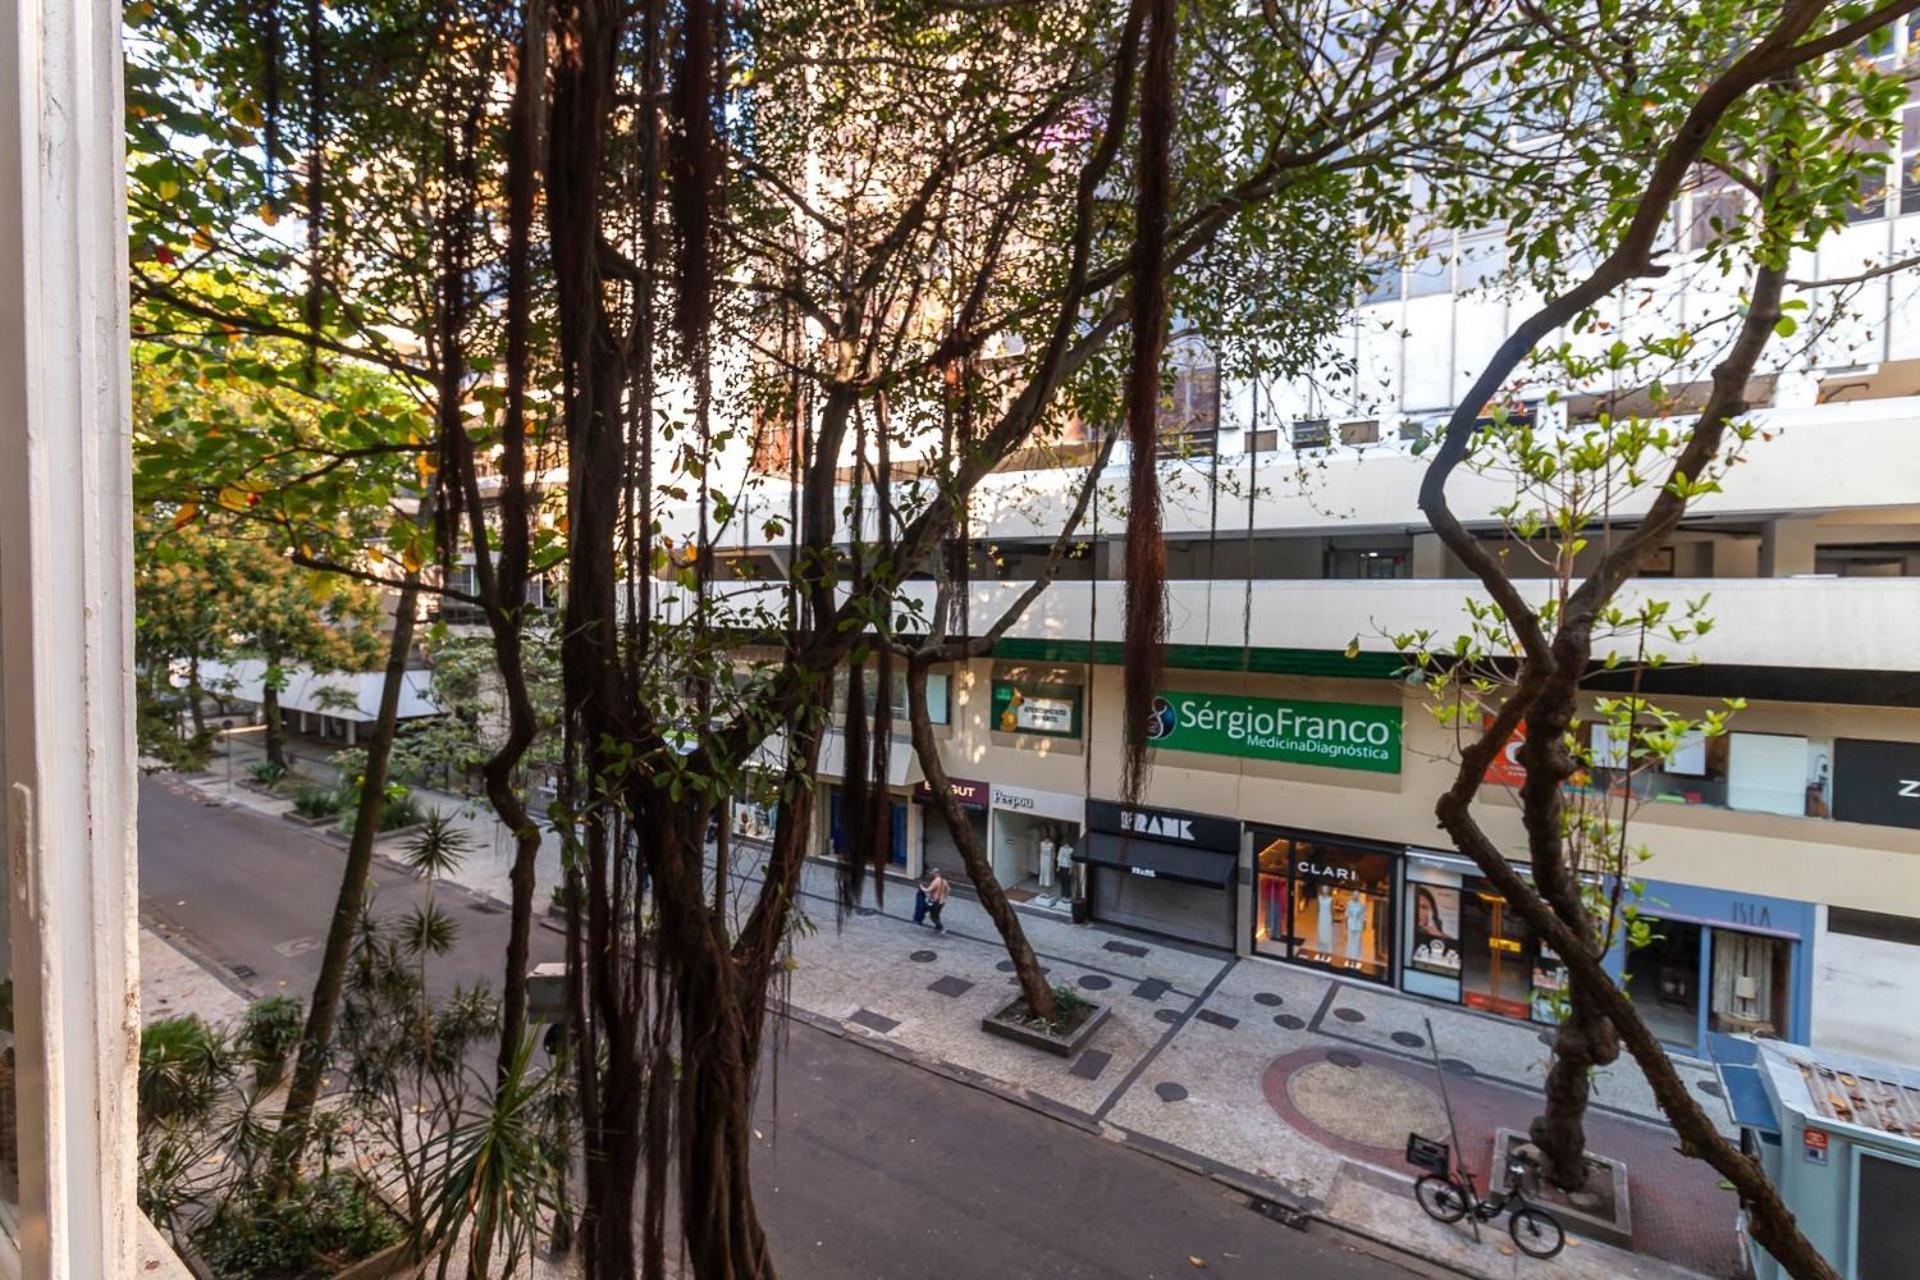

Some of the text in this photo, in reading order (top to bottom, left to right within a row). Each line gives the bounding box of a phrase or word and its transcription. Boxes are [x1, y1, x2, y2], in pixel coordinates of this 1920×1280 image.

[1180, 700, 1390, 745] SérgioFranco
[1247, 734, 1390, 760] MedicinaDiagnóstica
[1297, 861, 1357, 881] CLARI
[1732, 900, 1772, 928] ISLA
